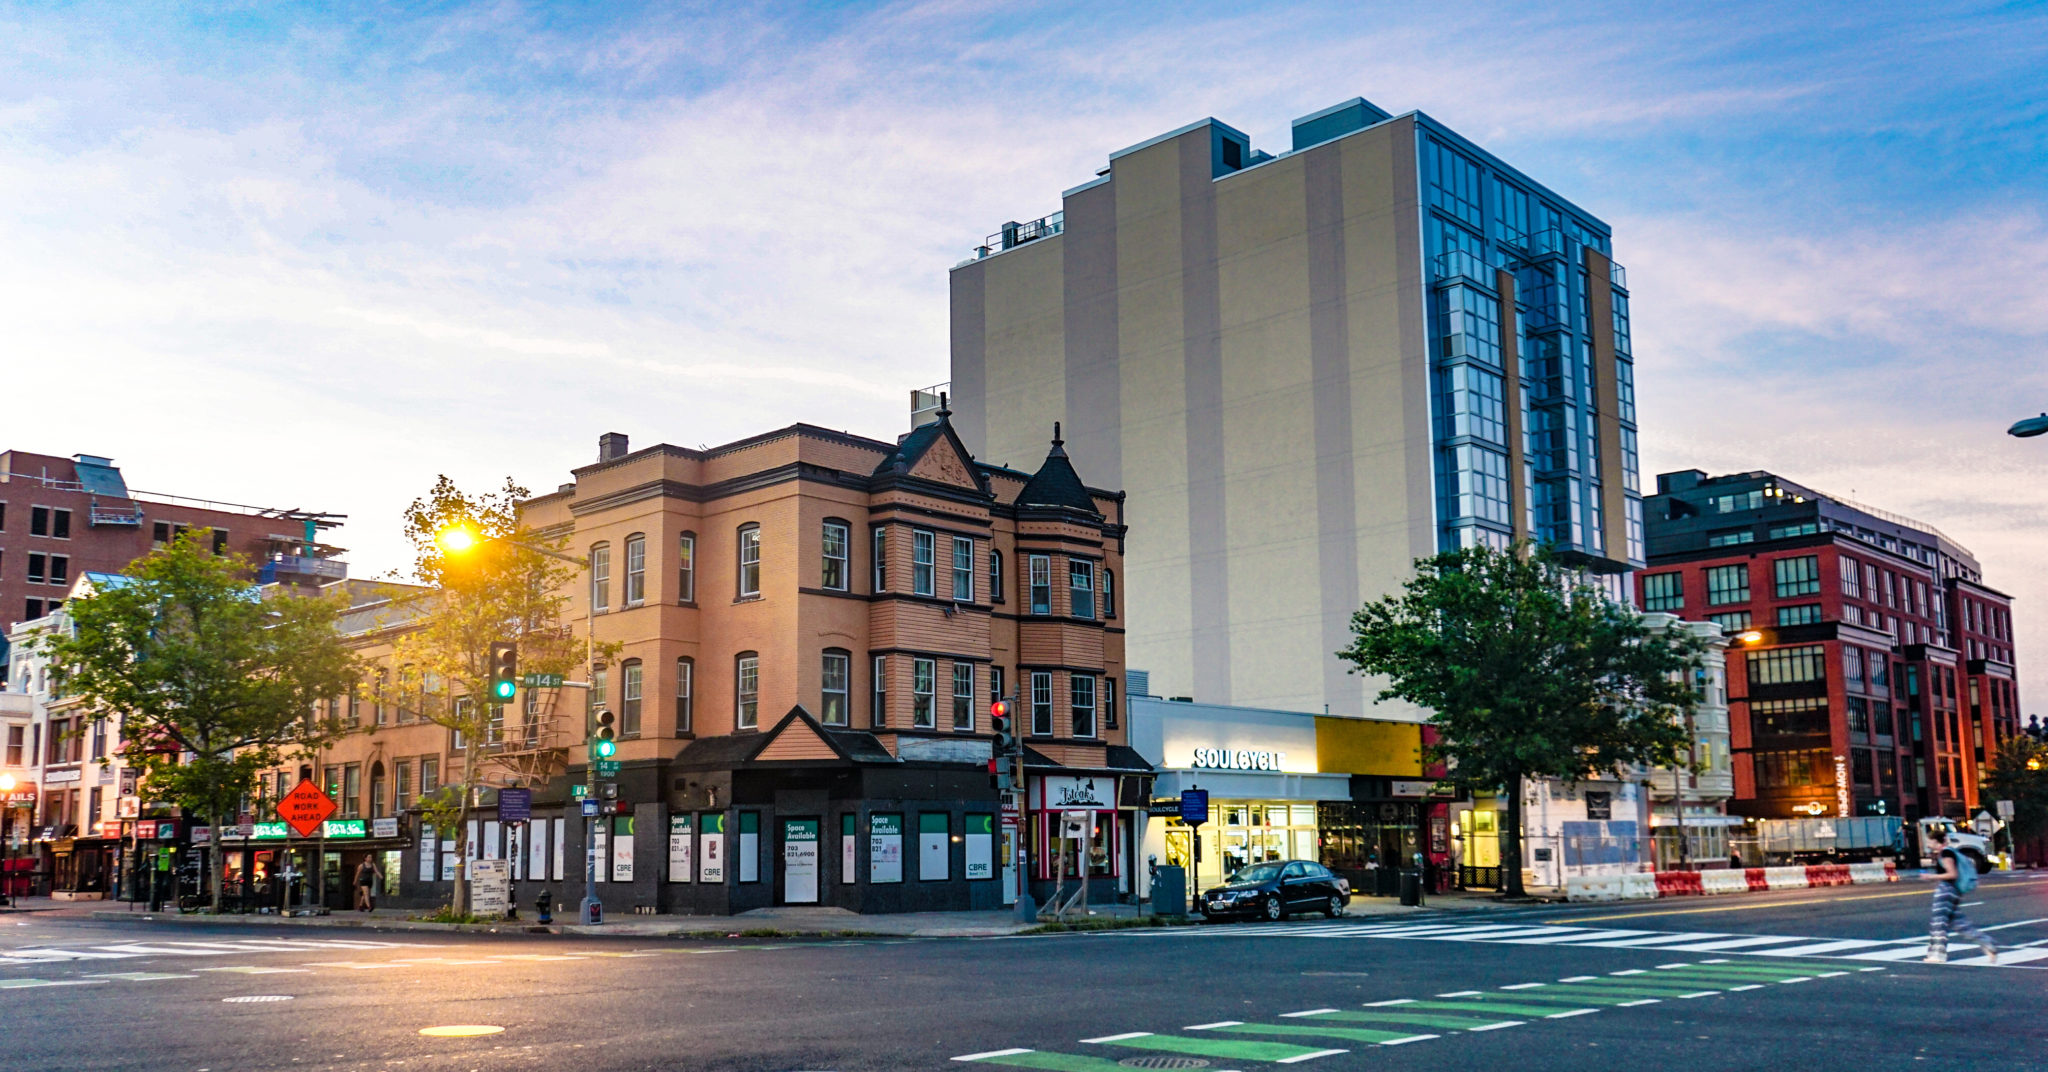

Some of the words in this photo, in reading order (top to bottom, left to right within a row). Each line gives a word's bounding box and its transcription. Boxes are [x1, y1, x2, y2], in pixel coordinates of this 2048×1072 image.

[525, 676, 535, 684] NW
[536, 674, 551, 686] 14
[553, 677, 561, 685] ST
[1194, 747, 1286, 771] SOULCYCLE
[1835, 763, 1846, 788] NOW
[576, 786, 582, 795] U
[291, 813, 321, 821] AHEAD
[671, 816, 685, 824] Space
[871, 815, 888, 824] Space
[671, 825, 691, 834] Available
[787, 824, 805, 832] Space
[871, 825, 898, 834] Available
[787, 831, 816, 840] Available
[616, 864, 632, 872] CBRE
[968, 863, 987, 871] CBRE
[703, 868, 721, 876] CBRE
